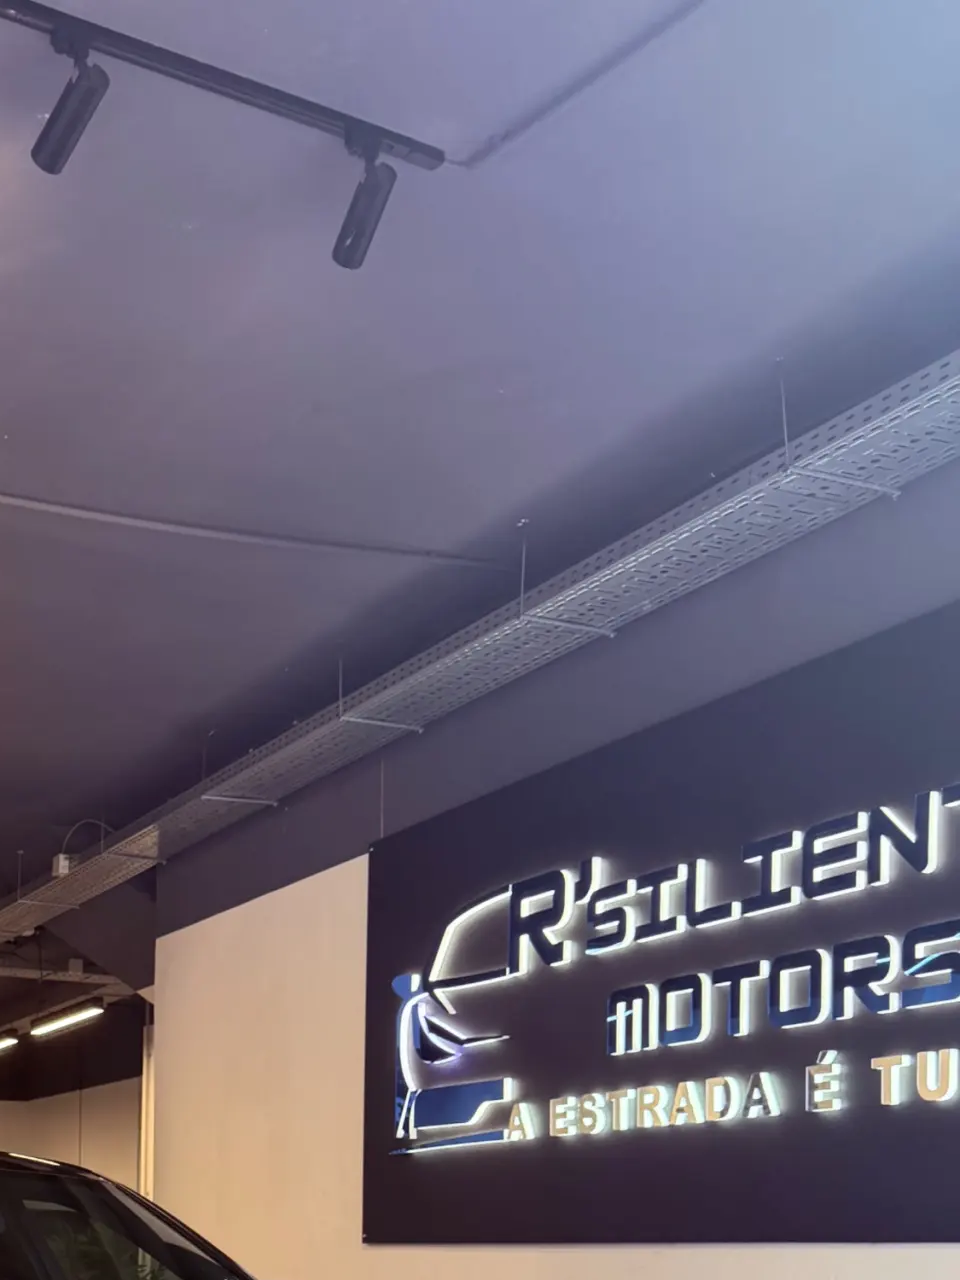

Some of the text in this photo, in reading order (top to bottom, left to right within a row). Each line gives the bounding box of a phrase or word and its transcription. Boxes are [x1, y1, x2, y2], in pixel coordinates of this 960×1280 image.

[607, 918, 960, 1056] MOTORS
[507, 1101, 536, 1141] A
[549, 1071, 782, 1137] ESTRADA
[805, 1049, 843, 1112] É
